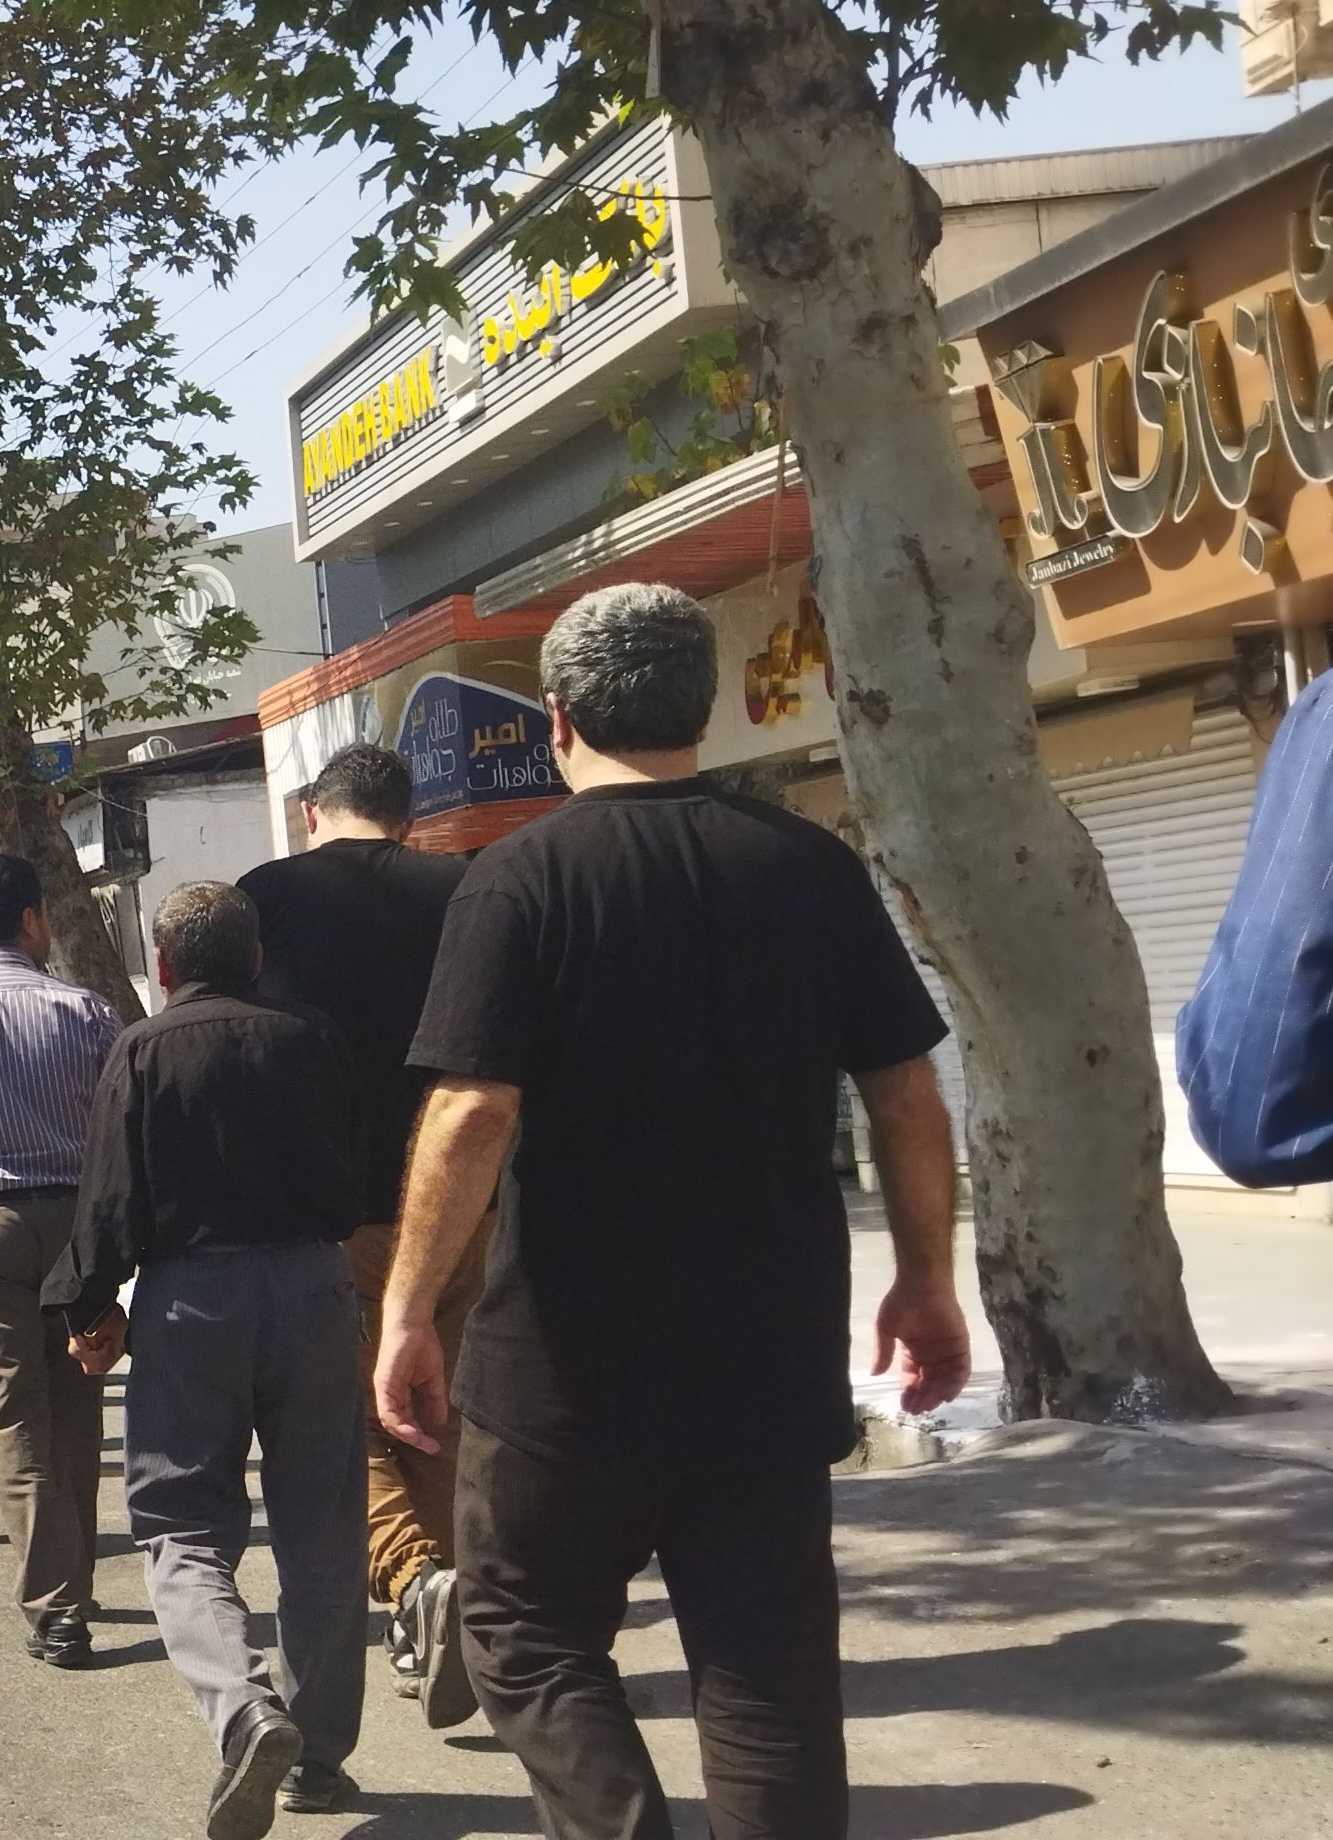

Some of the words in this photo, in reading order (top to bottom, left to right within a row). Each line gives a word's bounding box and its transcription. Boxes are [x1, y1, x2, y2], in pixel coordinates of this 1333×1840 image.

[302, 390, 378, 498] AYANDEH
[379, 346, 436, 441] BANK
[1032, 553, 1072, 581] Janbazi
[1073, 543, 1114, 568] Jewelry
[469, 713, 526, 759] امیر
[467, 756, 569, 791] واهرات
